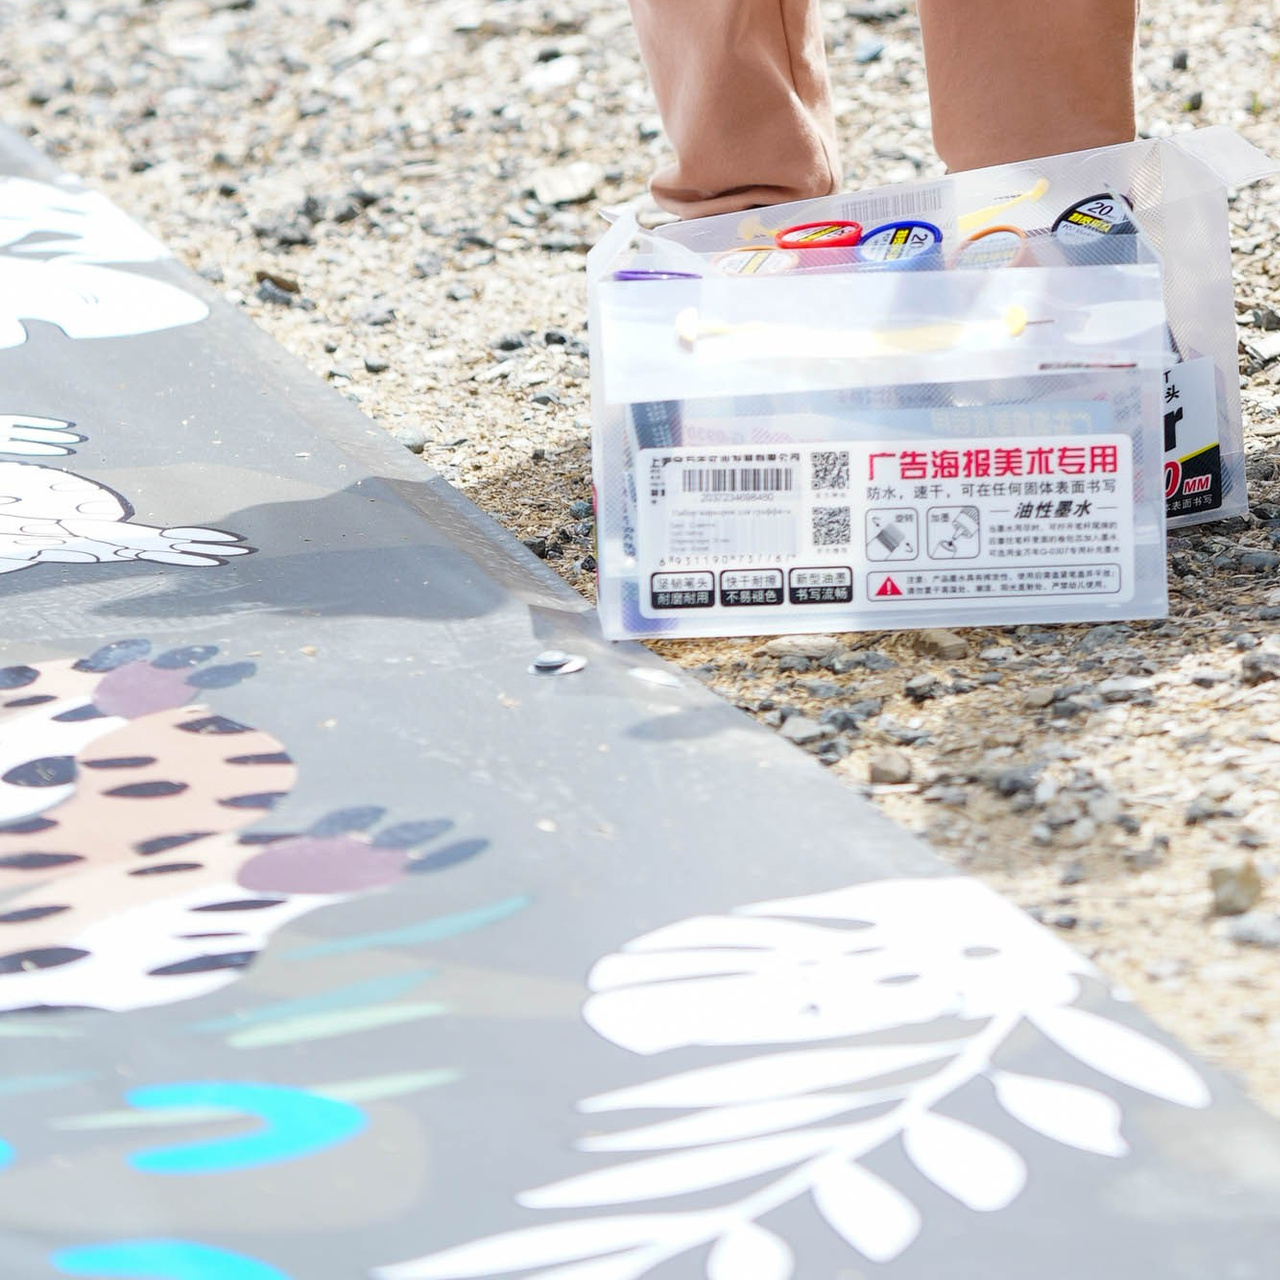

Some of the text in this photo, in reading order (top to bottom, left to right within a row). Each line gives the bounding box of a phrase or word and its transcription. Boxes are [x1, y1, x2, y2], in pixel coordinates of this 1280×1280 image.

[1087, 202, 1114, 216] 20
[868, 445, 1117, 480] 广告海报美术专用
[1183, 474, 1212, 495] MM
[1014, 500, 1092, 518] 油性墨水
[657, 592, 710, 605] 耐磨耐用
[726, 590, 777, 603] 不易褪色
[795, 587, 847, 600] 书写流畅
